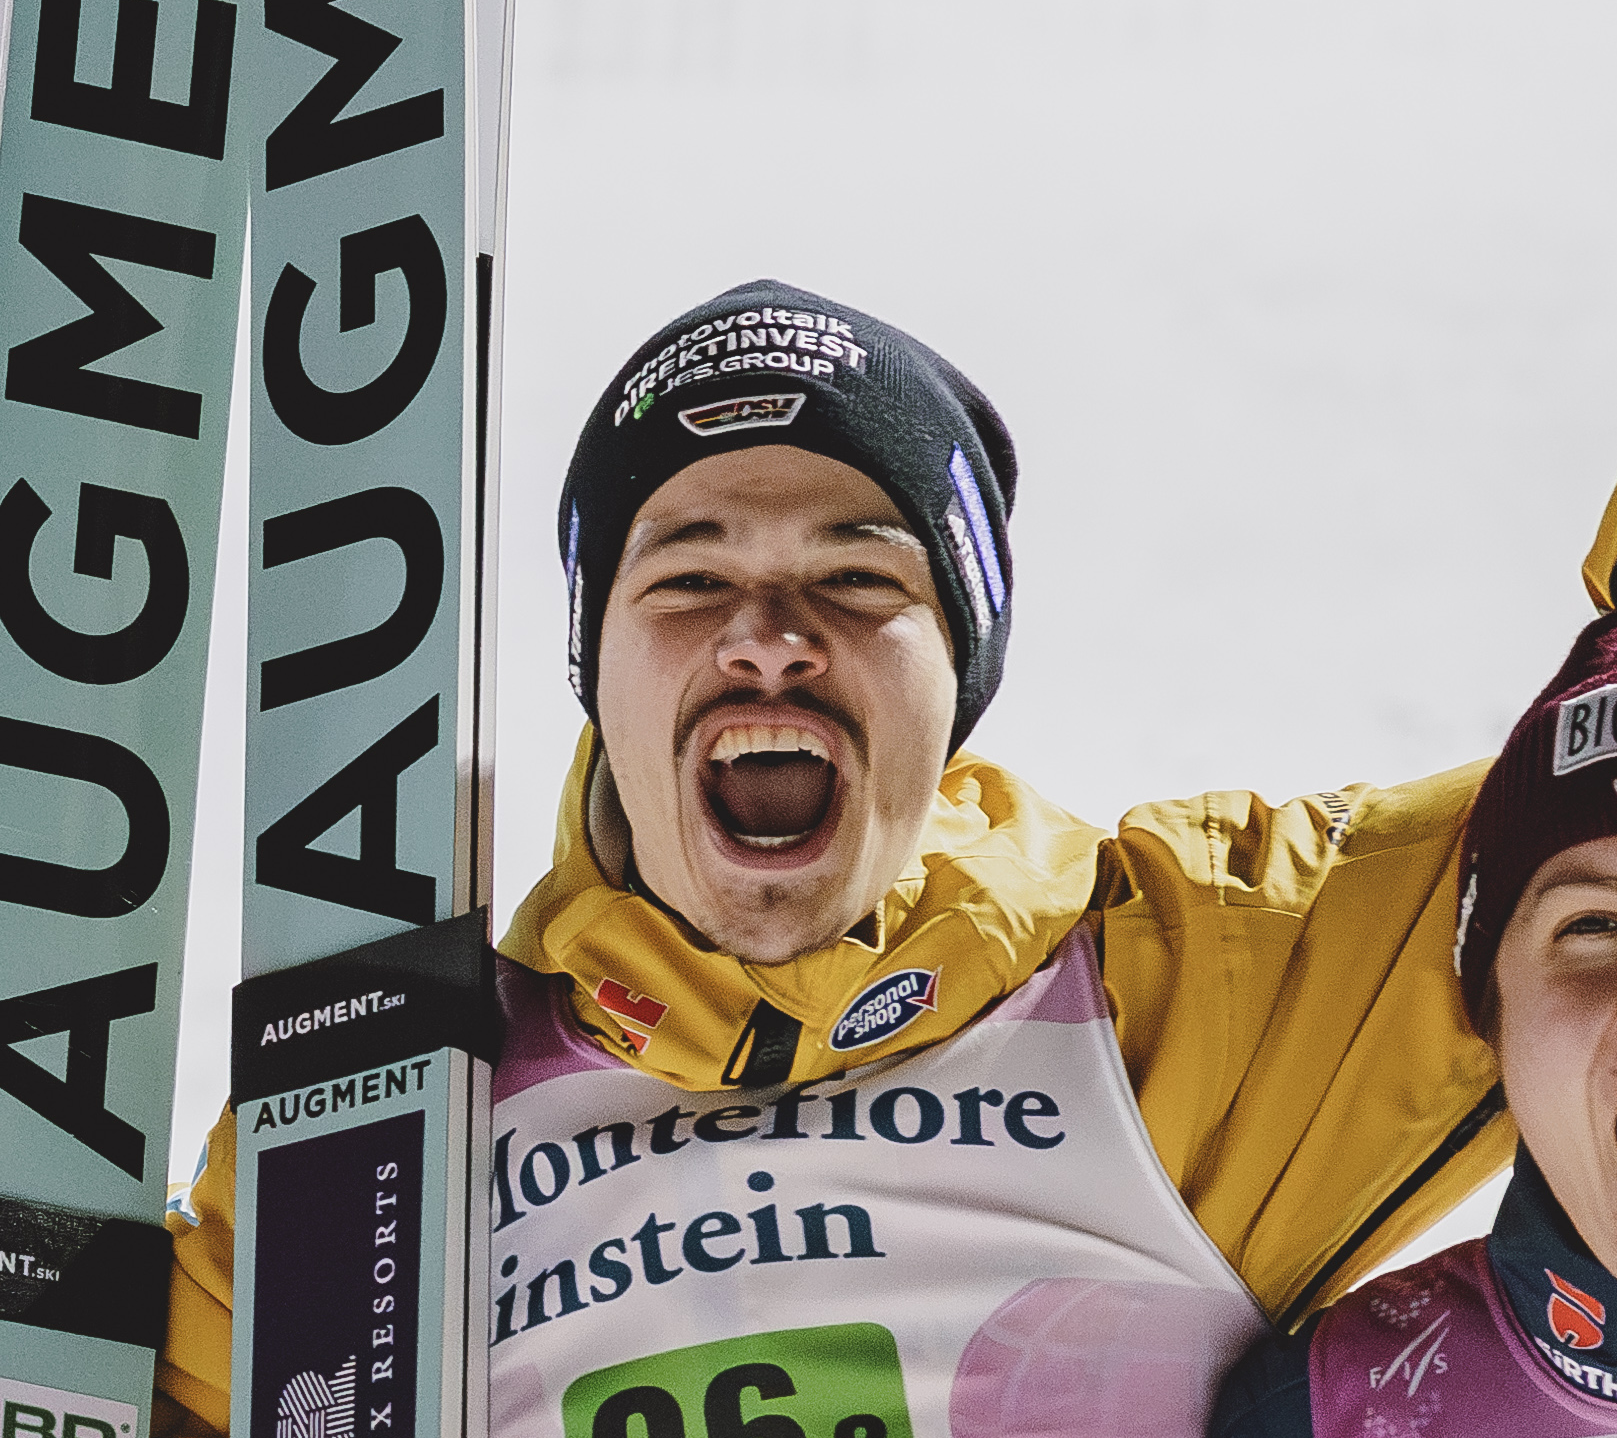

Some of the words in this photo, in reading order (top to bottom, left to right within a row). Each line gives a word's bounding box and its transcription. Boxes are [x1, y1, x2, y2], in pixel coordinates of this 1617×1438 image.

[614, 328, 868, 427] DIREKTINVEST
[837, 973, 919, 1041] personal
[853, 1002, 902, 1039] shop
[252, 1058, 433, 1134] AUGMENT
[495, 1070, 1067, 1235] ontefiore
[371, 1160, 400, 1383] RESORTS
[490, 1170, 886, 1348] instein
